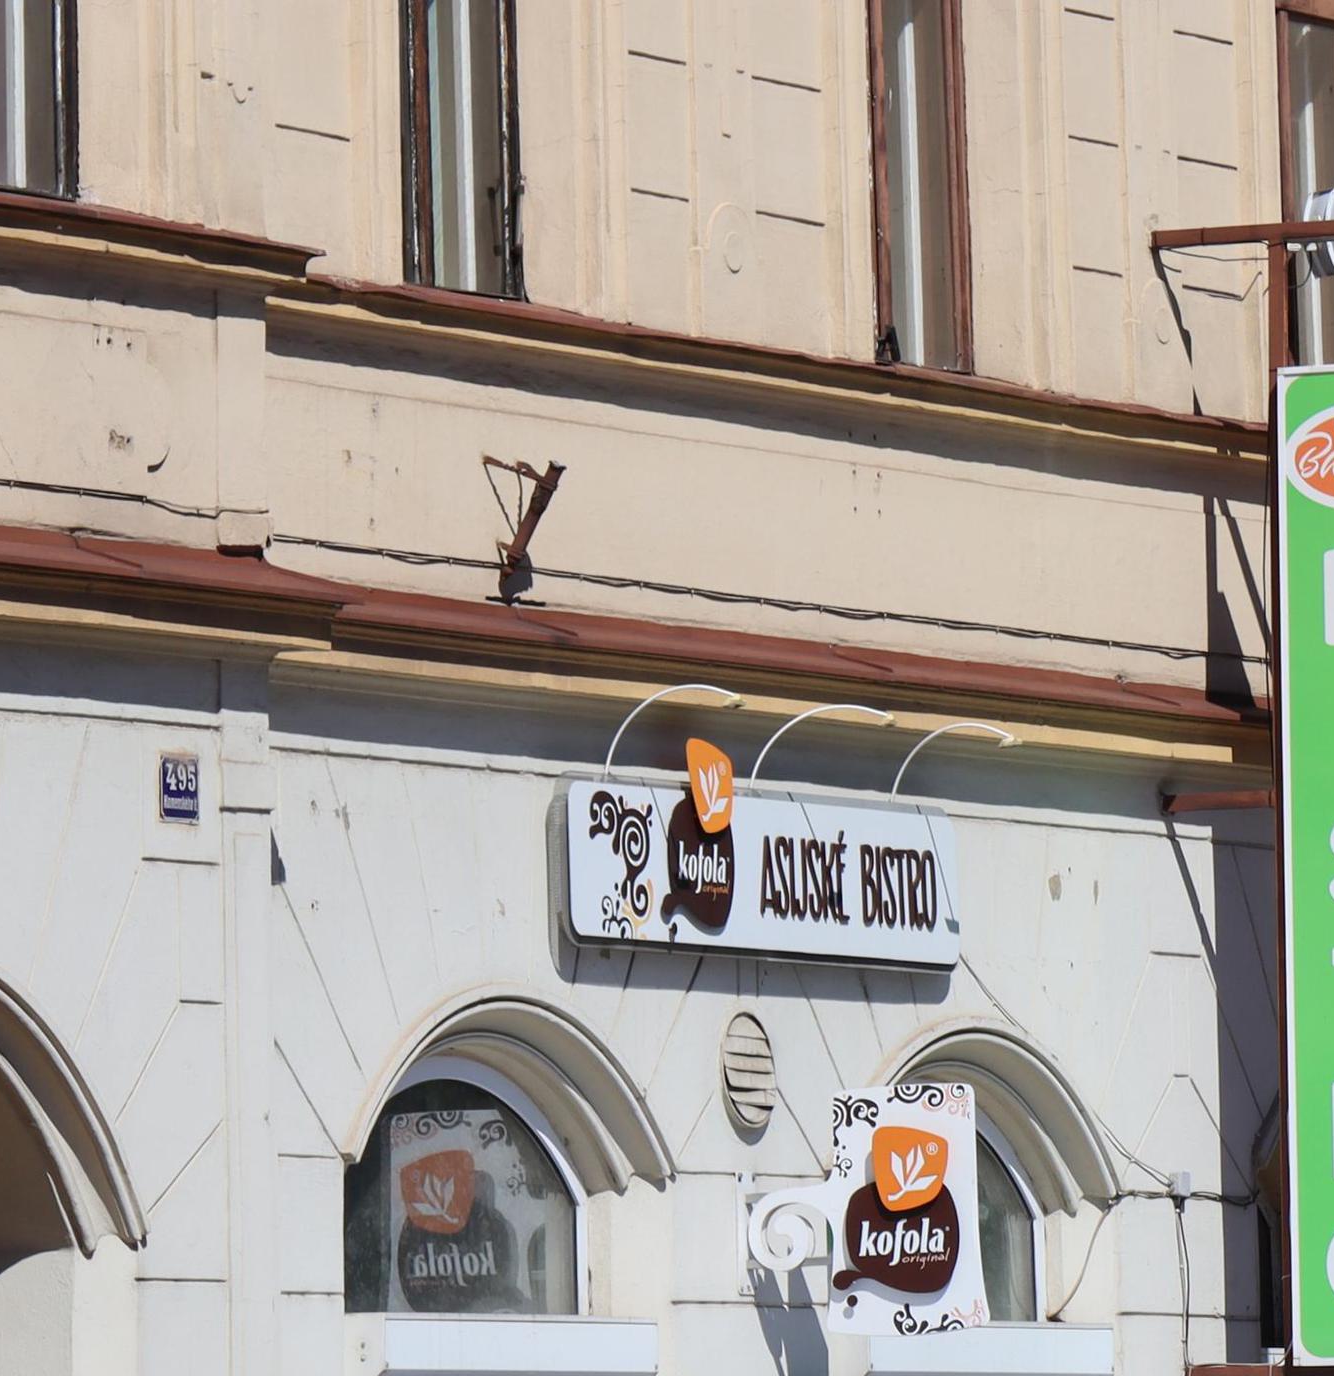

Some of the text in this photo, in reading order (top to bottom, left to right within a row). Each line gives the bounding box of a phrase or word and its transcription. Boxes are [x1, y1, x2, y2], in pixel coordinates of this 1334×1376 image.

[165, 763, 196, 792] 495
[679, 840, 728, 894] kofola
[760, 830, 938, 933] ASIJSKÉ BISTRO
[858, 1217, 945, 1267] kofola
[901, 1247, 951, 1270] original
